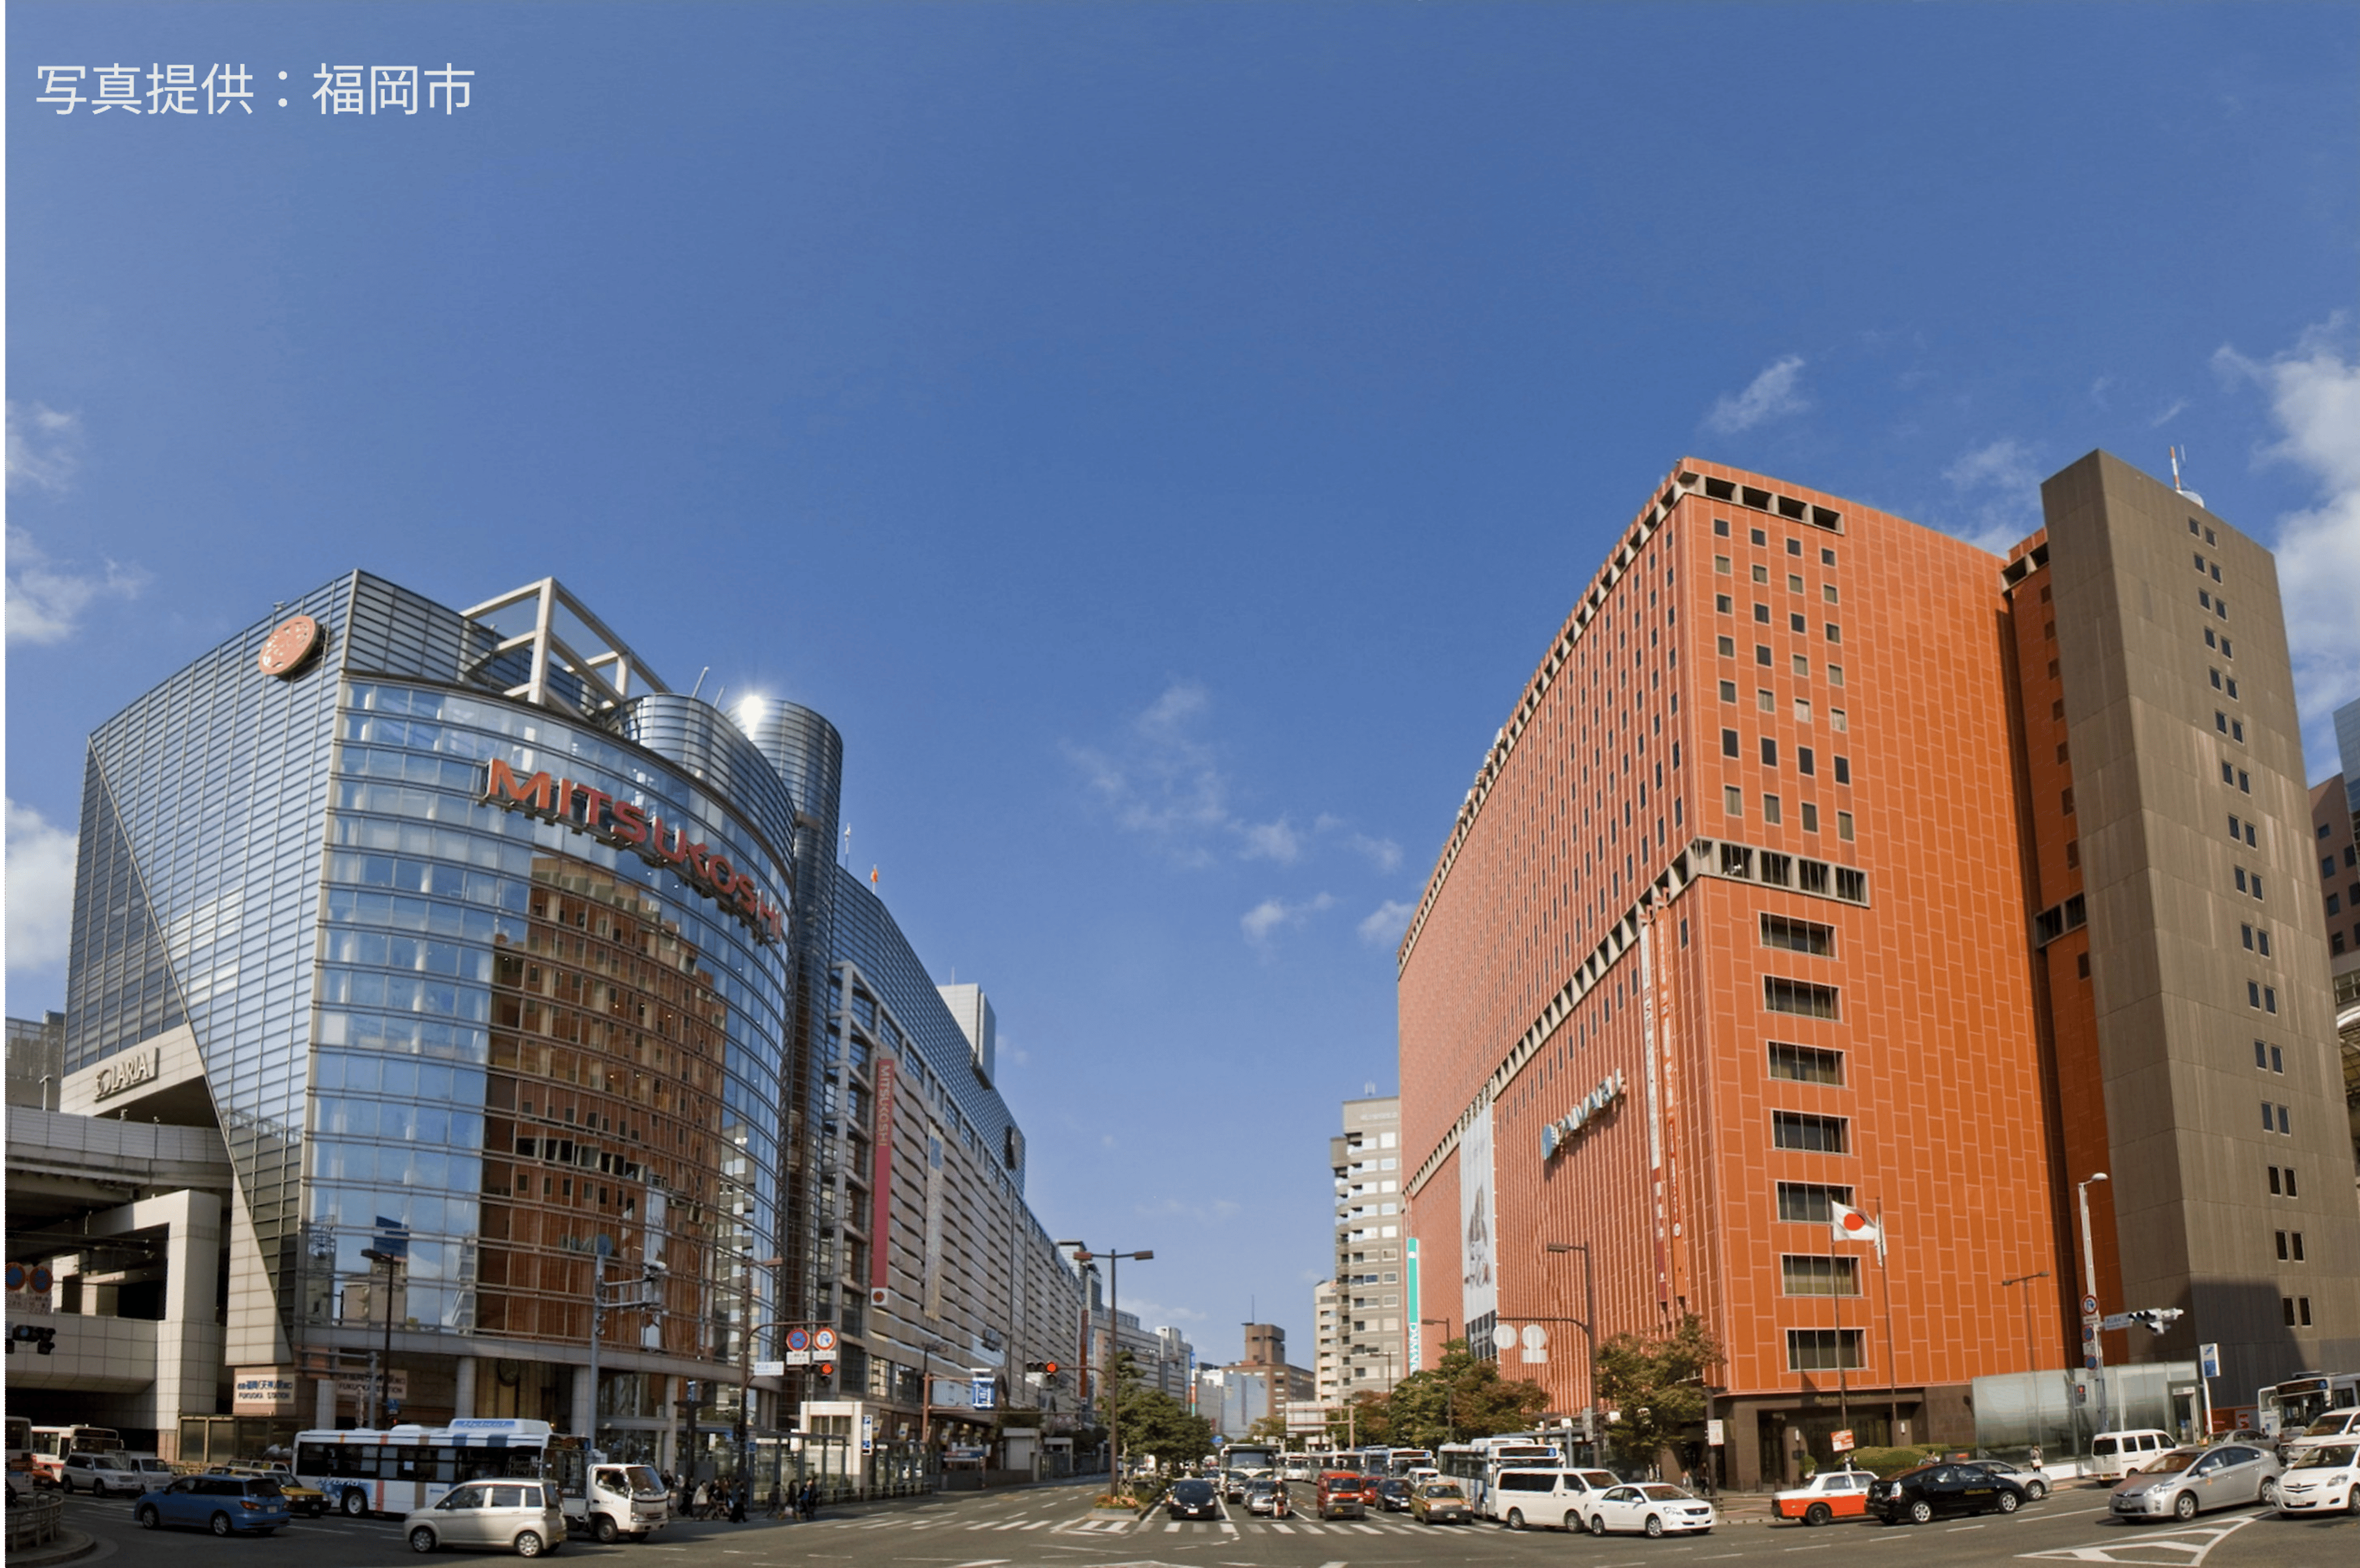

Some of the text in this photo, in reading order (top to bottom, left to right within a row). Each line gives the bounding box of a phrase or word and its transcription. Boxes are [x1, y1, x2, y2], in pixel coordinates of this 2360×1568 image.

[486, 757, 782, 943] MITSUKOSHI
[96, 1052, 149, 1098] SOLARIA
[877, 1064, 891, 1147] MITSUKOSHI
